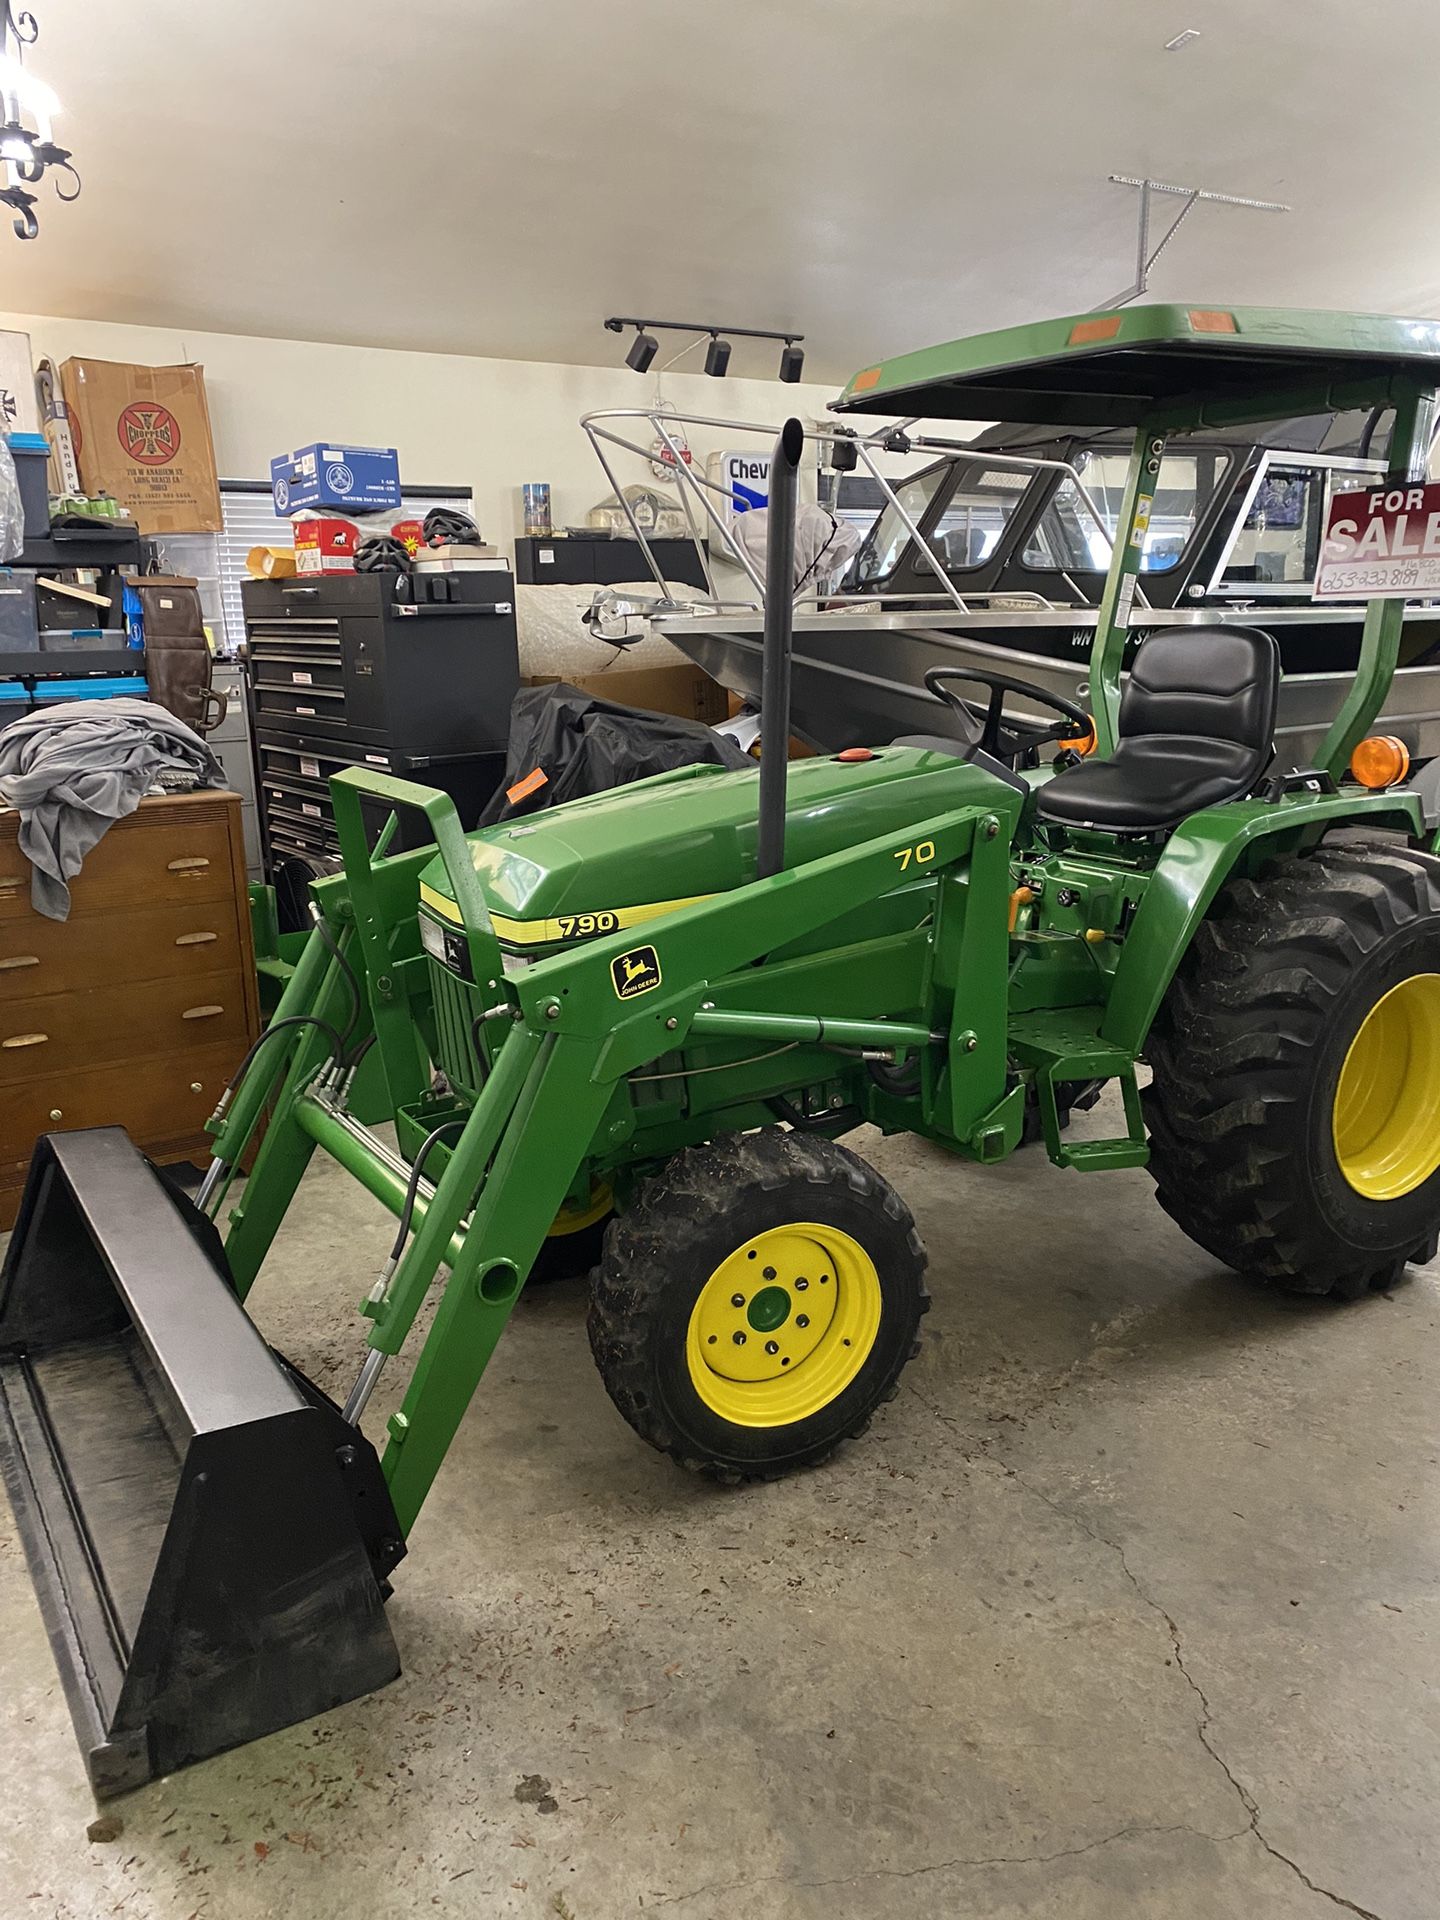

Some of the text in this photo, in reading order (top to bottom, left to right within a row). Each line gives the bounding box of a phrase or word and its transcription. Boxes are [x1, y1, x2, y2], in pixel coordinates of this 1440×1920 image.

[128, 424, 171, 444] CHOPPERS
[729, 458, 770, 479] Chev
[1367, 488, 1425, 514] FOR
[1071, 629, 1094, 646] WN
[894, 840, 936, 871] 70
[558, 912, 619, 938] 790
[621, 977, 658, 996] JOHN DEERE
